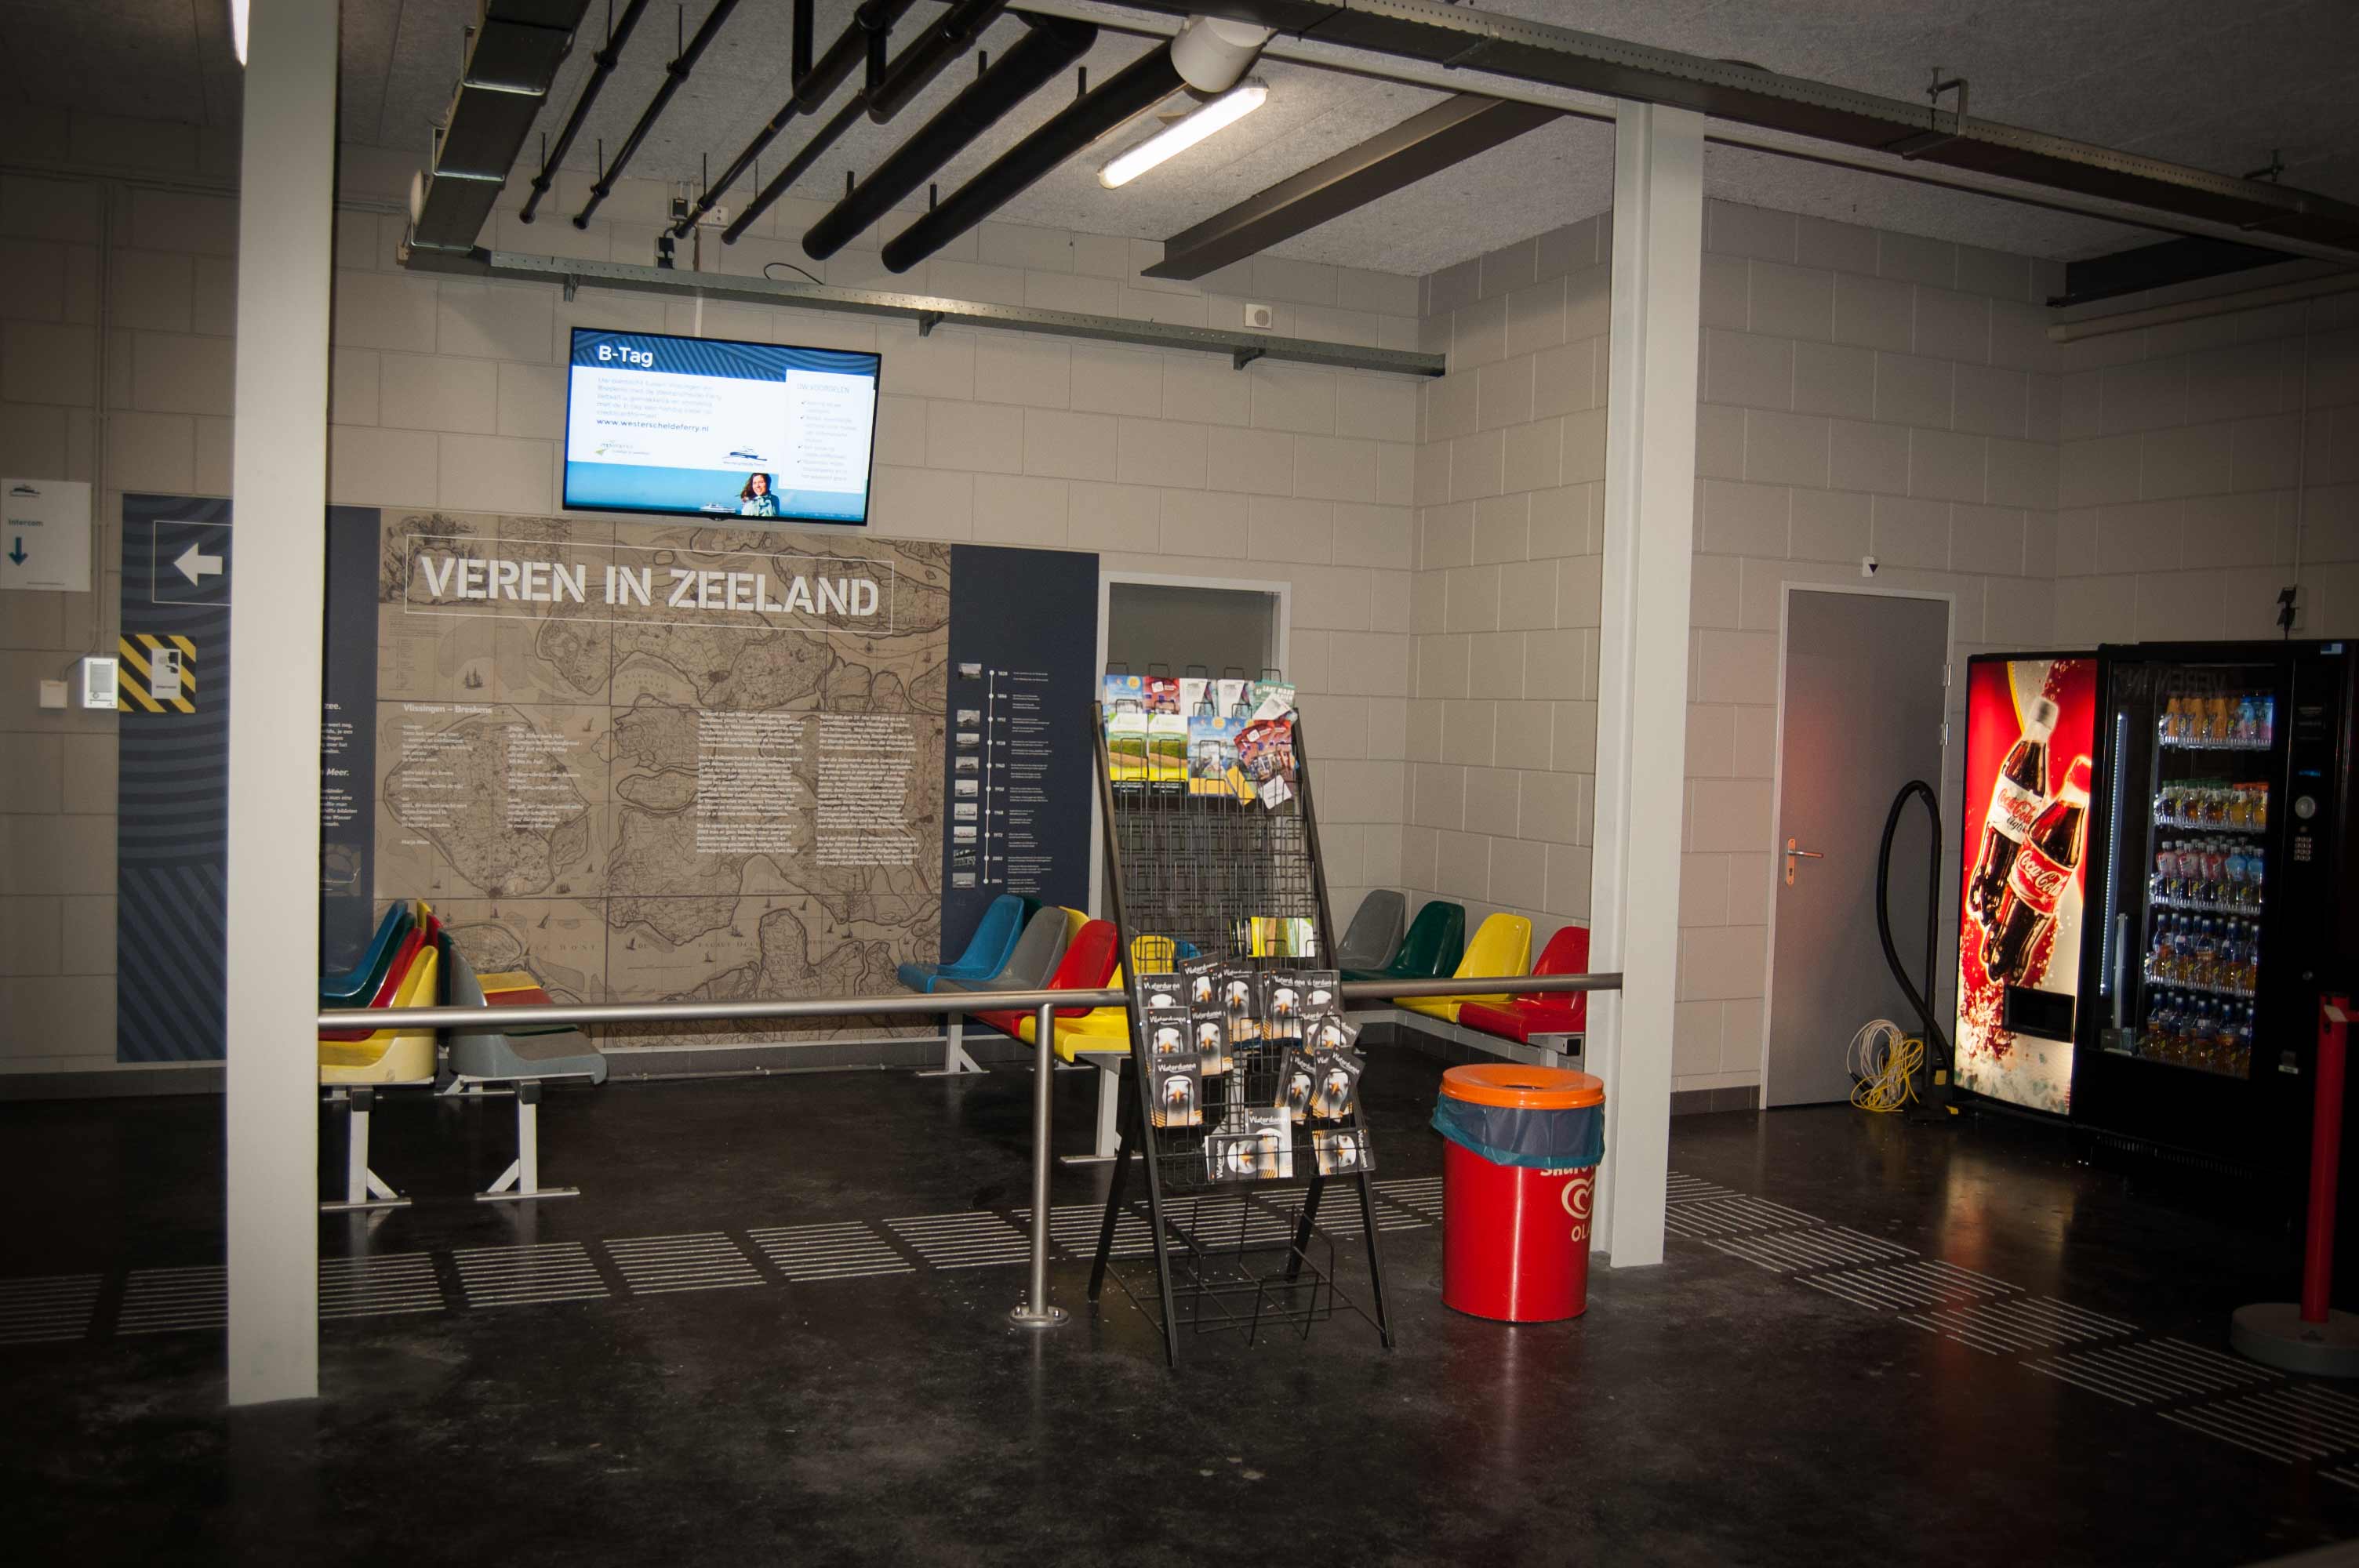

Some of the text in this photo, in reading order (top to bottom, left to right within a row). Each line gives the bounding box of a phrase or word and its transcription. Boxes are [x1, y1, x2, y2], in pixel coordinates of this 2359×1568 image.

[598, 345, 653, 368] B-Tag
[597, 419, 709, 433] www.westerscheldeferry.nl
[9, 518, 44, 527] Intercom
[421, 557, 879, 616] VEREN IN ZEELAND
[404, 704, 445, 713] Vlissingen
[455, 705, 493, 713] Breskens
[326, 768, 349, 776] Meer.
[1158, 1063, 1197, 1073] Waterdunen
